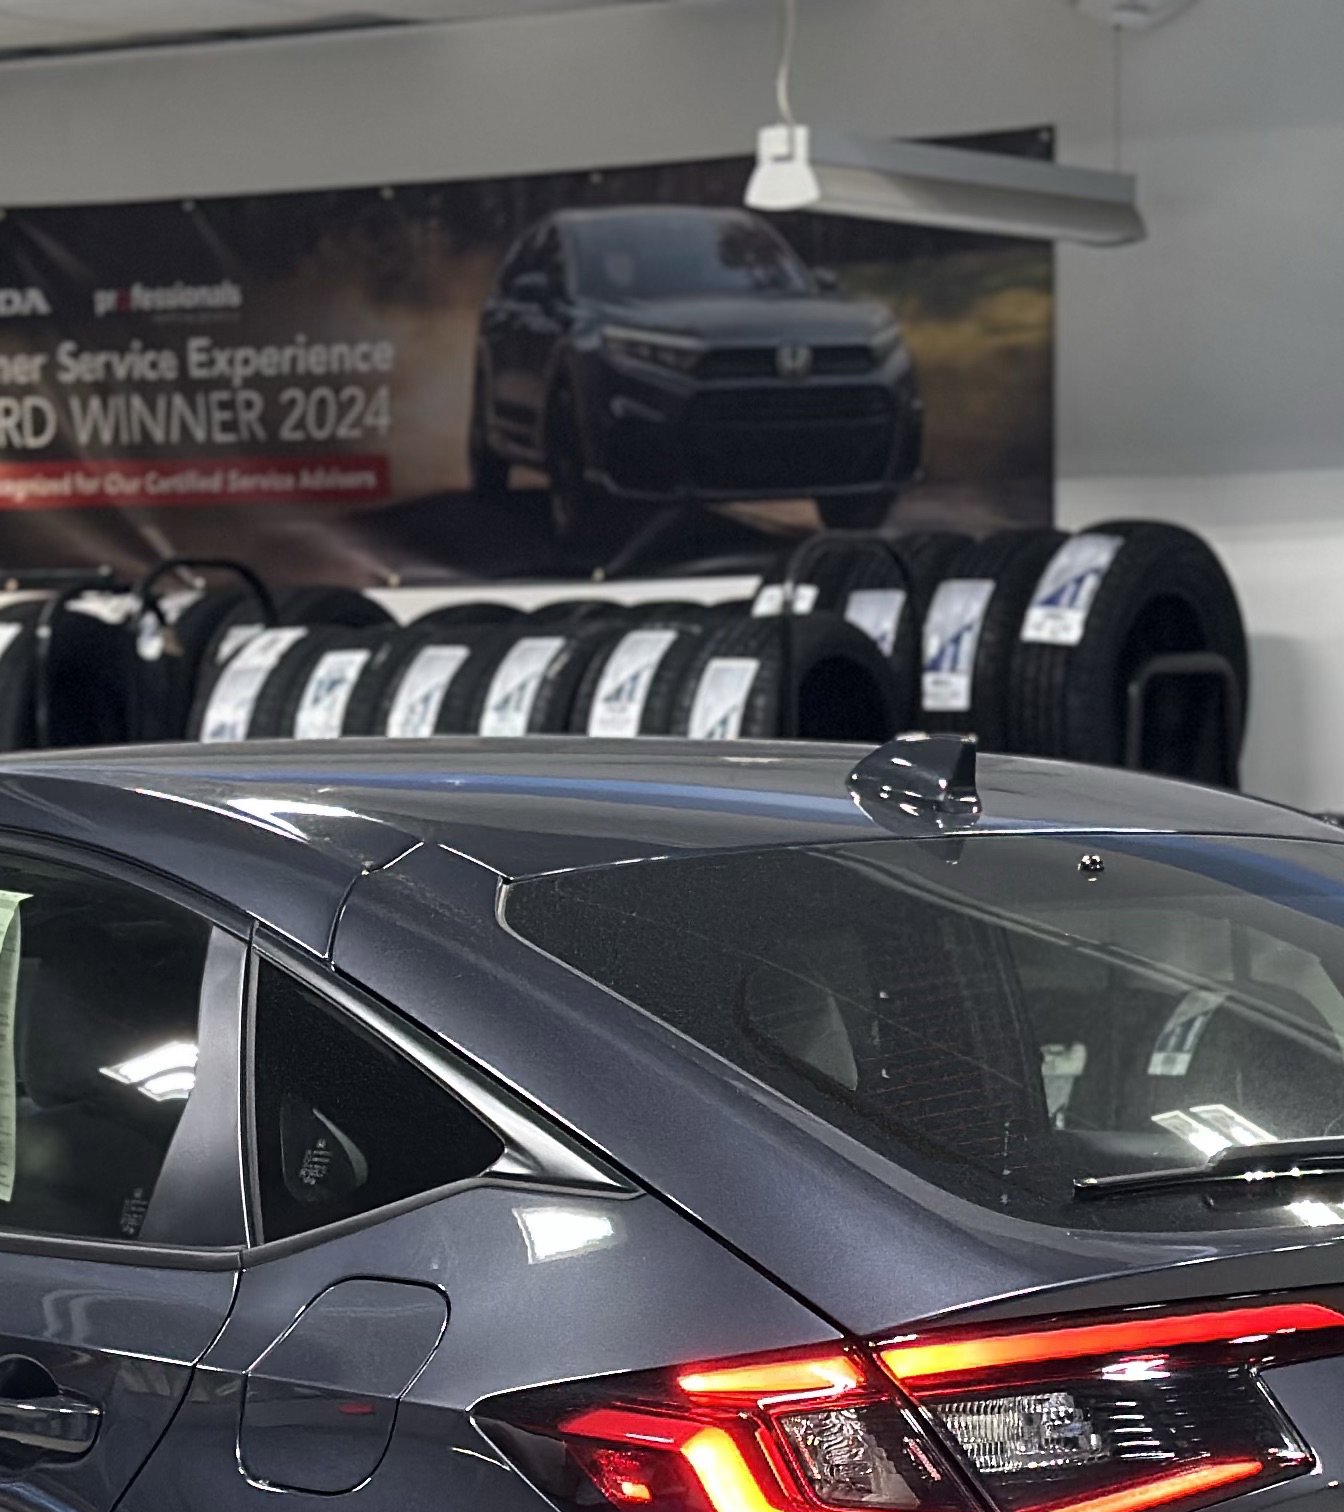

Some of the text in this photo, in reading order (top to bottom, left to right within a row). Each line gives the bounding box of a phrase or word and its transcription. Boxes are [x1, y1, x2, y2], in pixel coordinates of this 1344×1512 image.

[57, 339, 178, 384] Service
[187, 334, 394, 387] Experience
[71, 391, 265, 447] WINNER
[279, 386, 393, 442] 2024
[103, 471, 141, 496] Our
